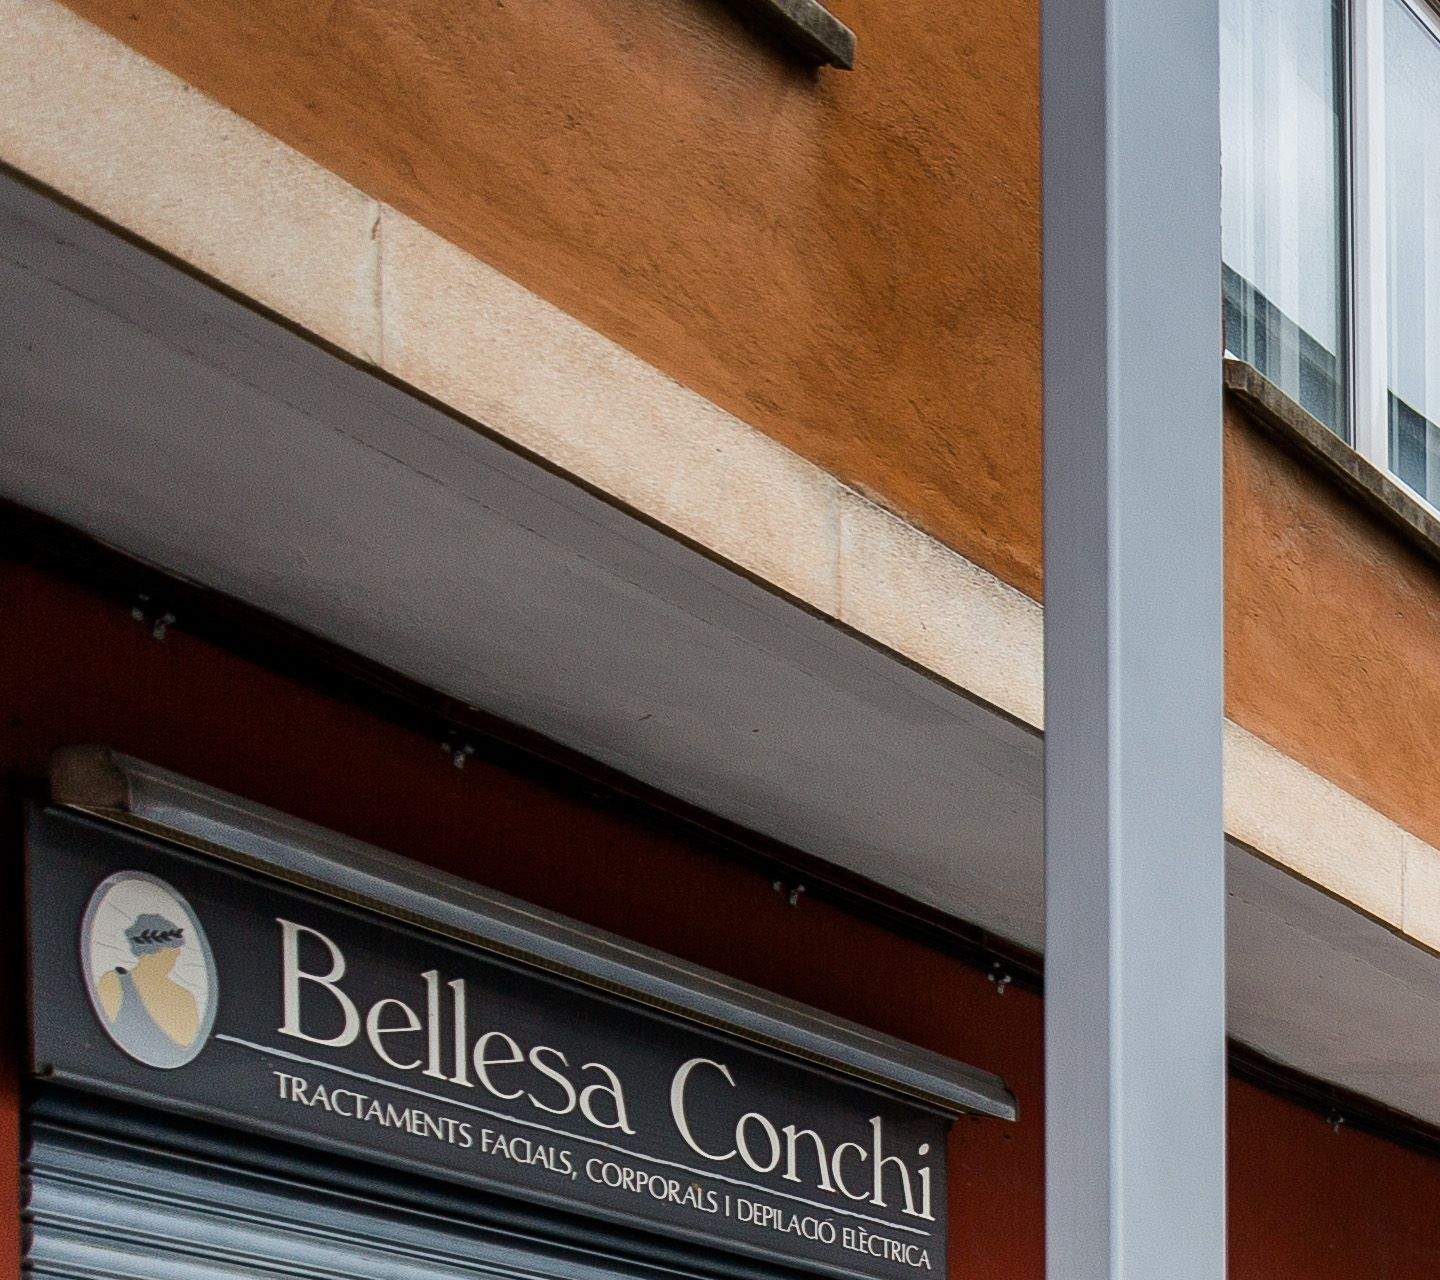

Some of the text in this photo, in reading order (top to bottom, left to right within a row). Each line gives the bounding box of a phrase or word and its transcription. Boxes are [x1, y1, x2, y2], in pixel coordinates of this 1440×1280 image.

[272, 1070, 932, 1271] TRACTAMENTS FACIALS, CORPORALS I DEPILACIÓ ELÈCTRICA
[276, 917, 936, 1222] Bellesa Conchi
